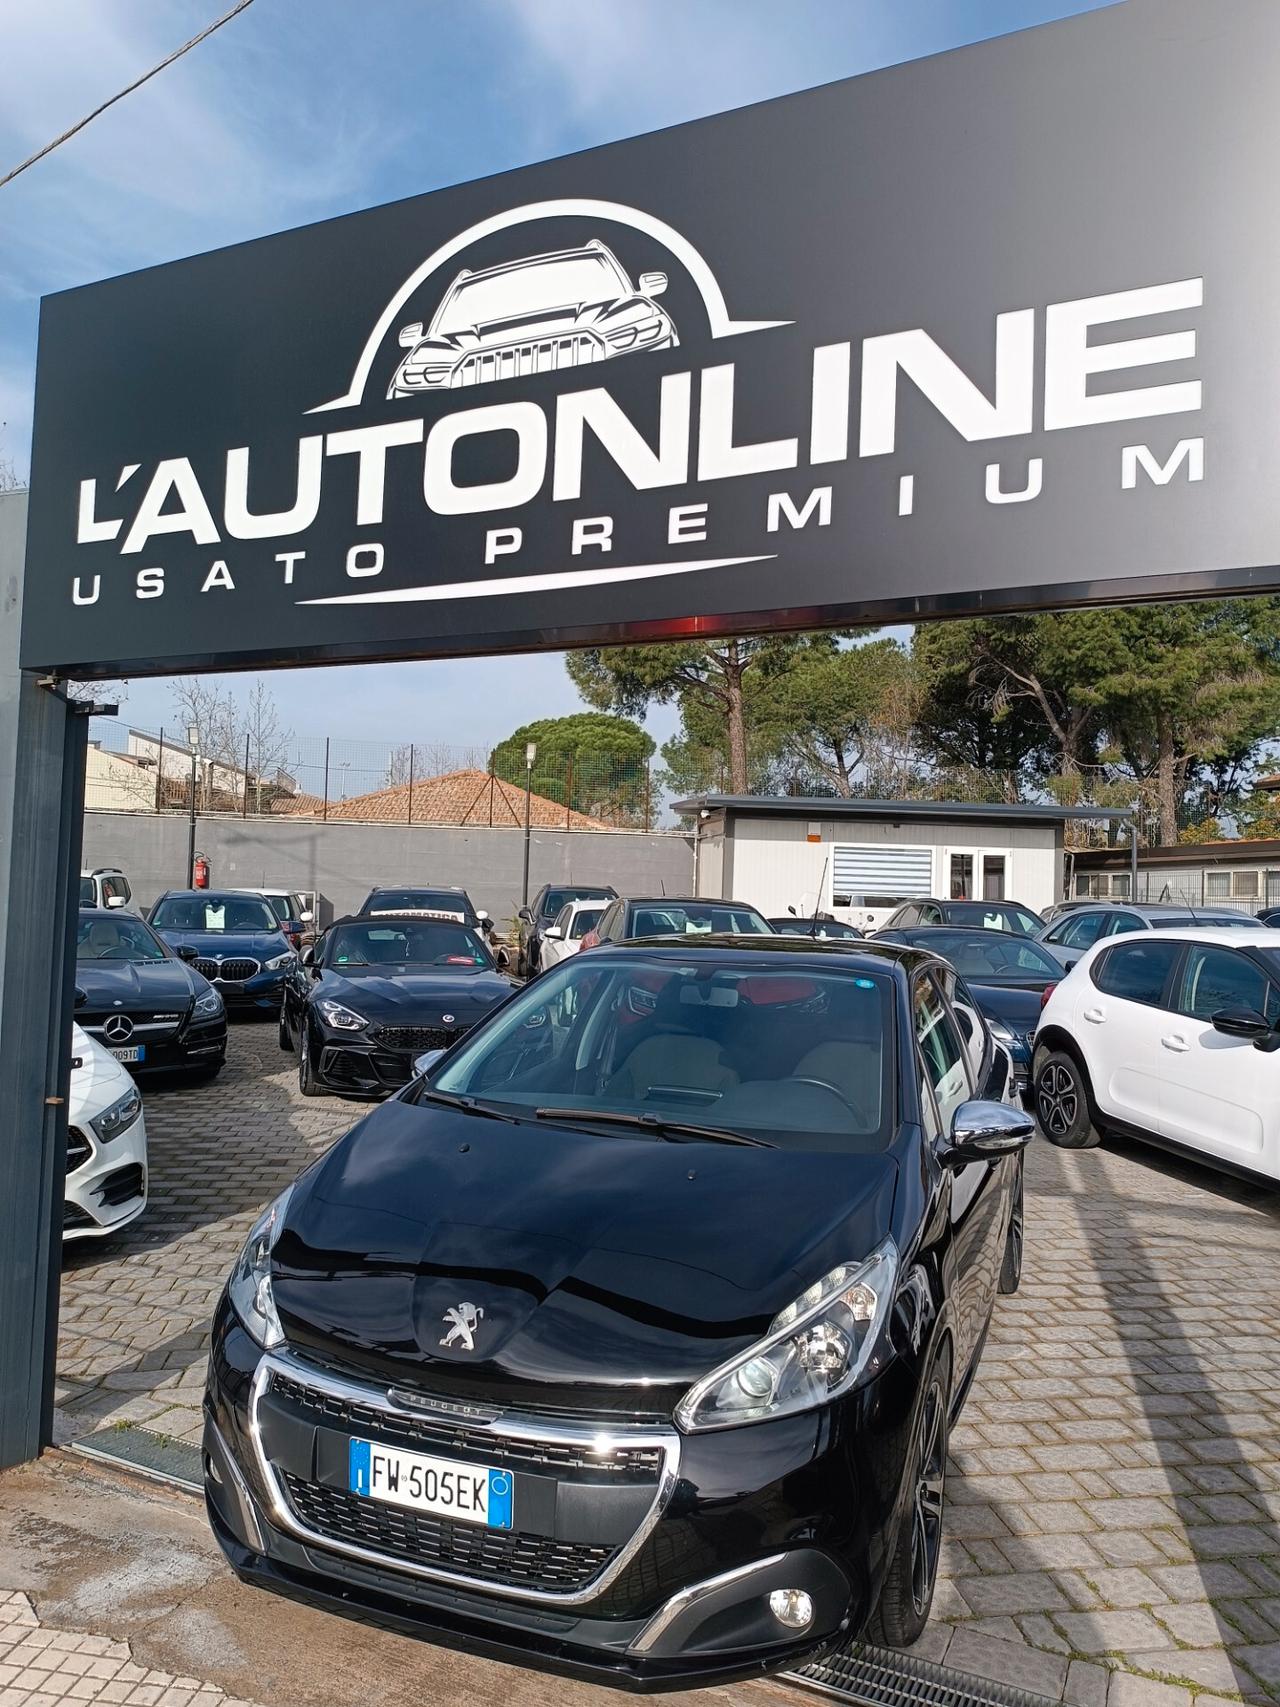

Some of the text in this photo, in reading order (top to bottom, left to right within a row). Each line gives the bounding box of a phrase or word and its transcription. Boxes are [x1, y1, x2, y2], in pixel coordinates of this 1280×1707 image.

[72, 437, 1205, 607] USATO PREMIUM
[373, 1455, 486, 1512] FW 505EK
